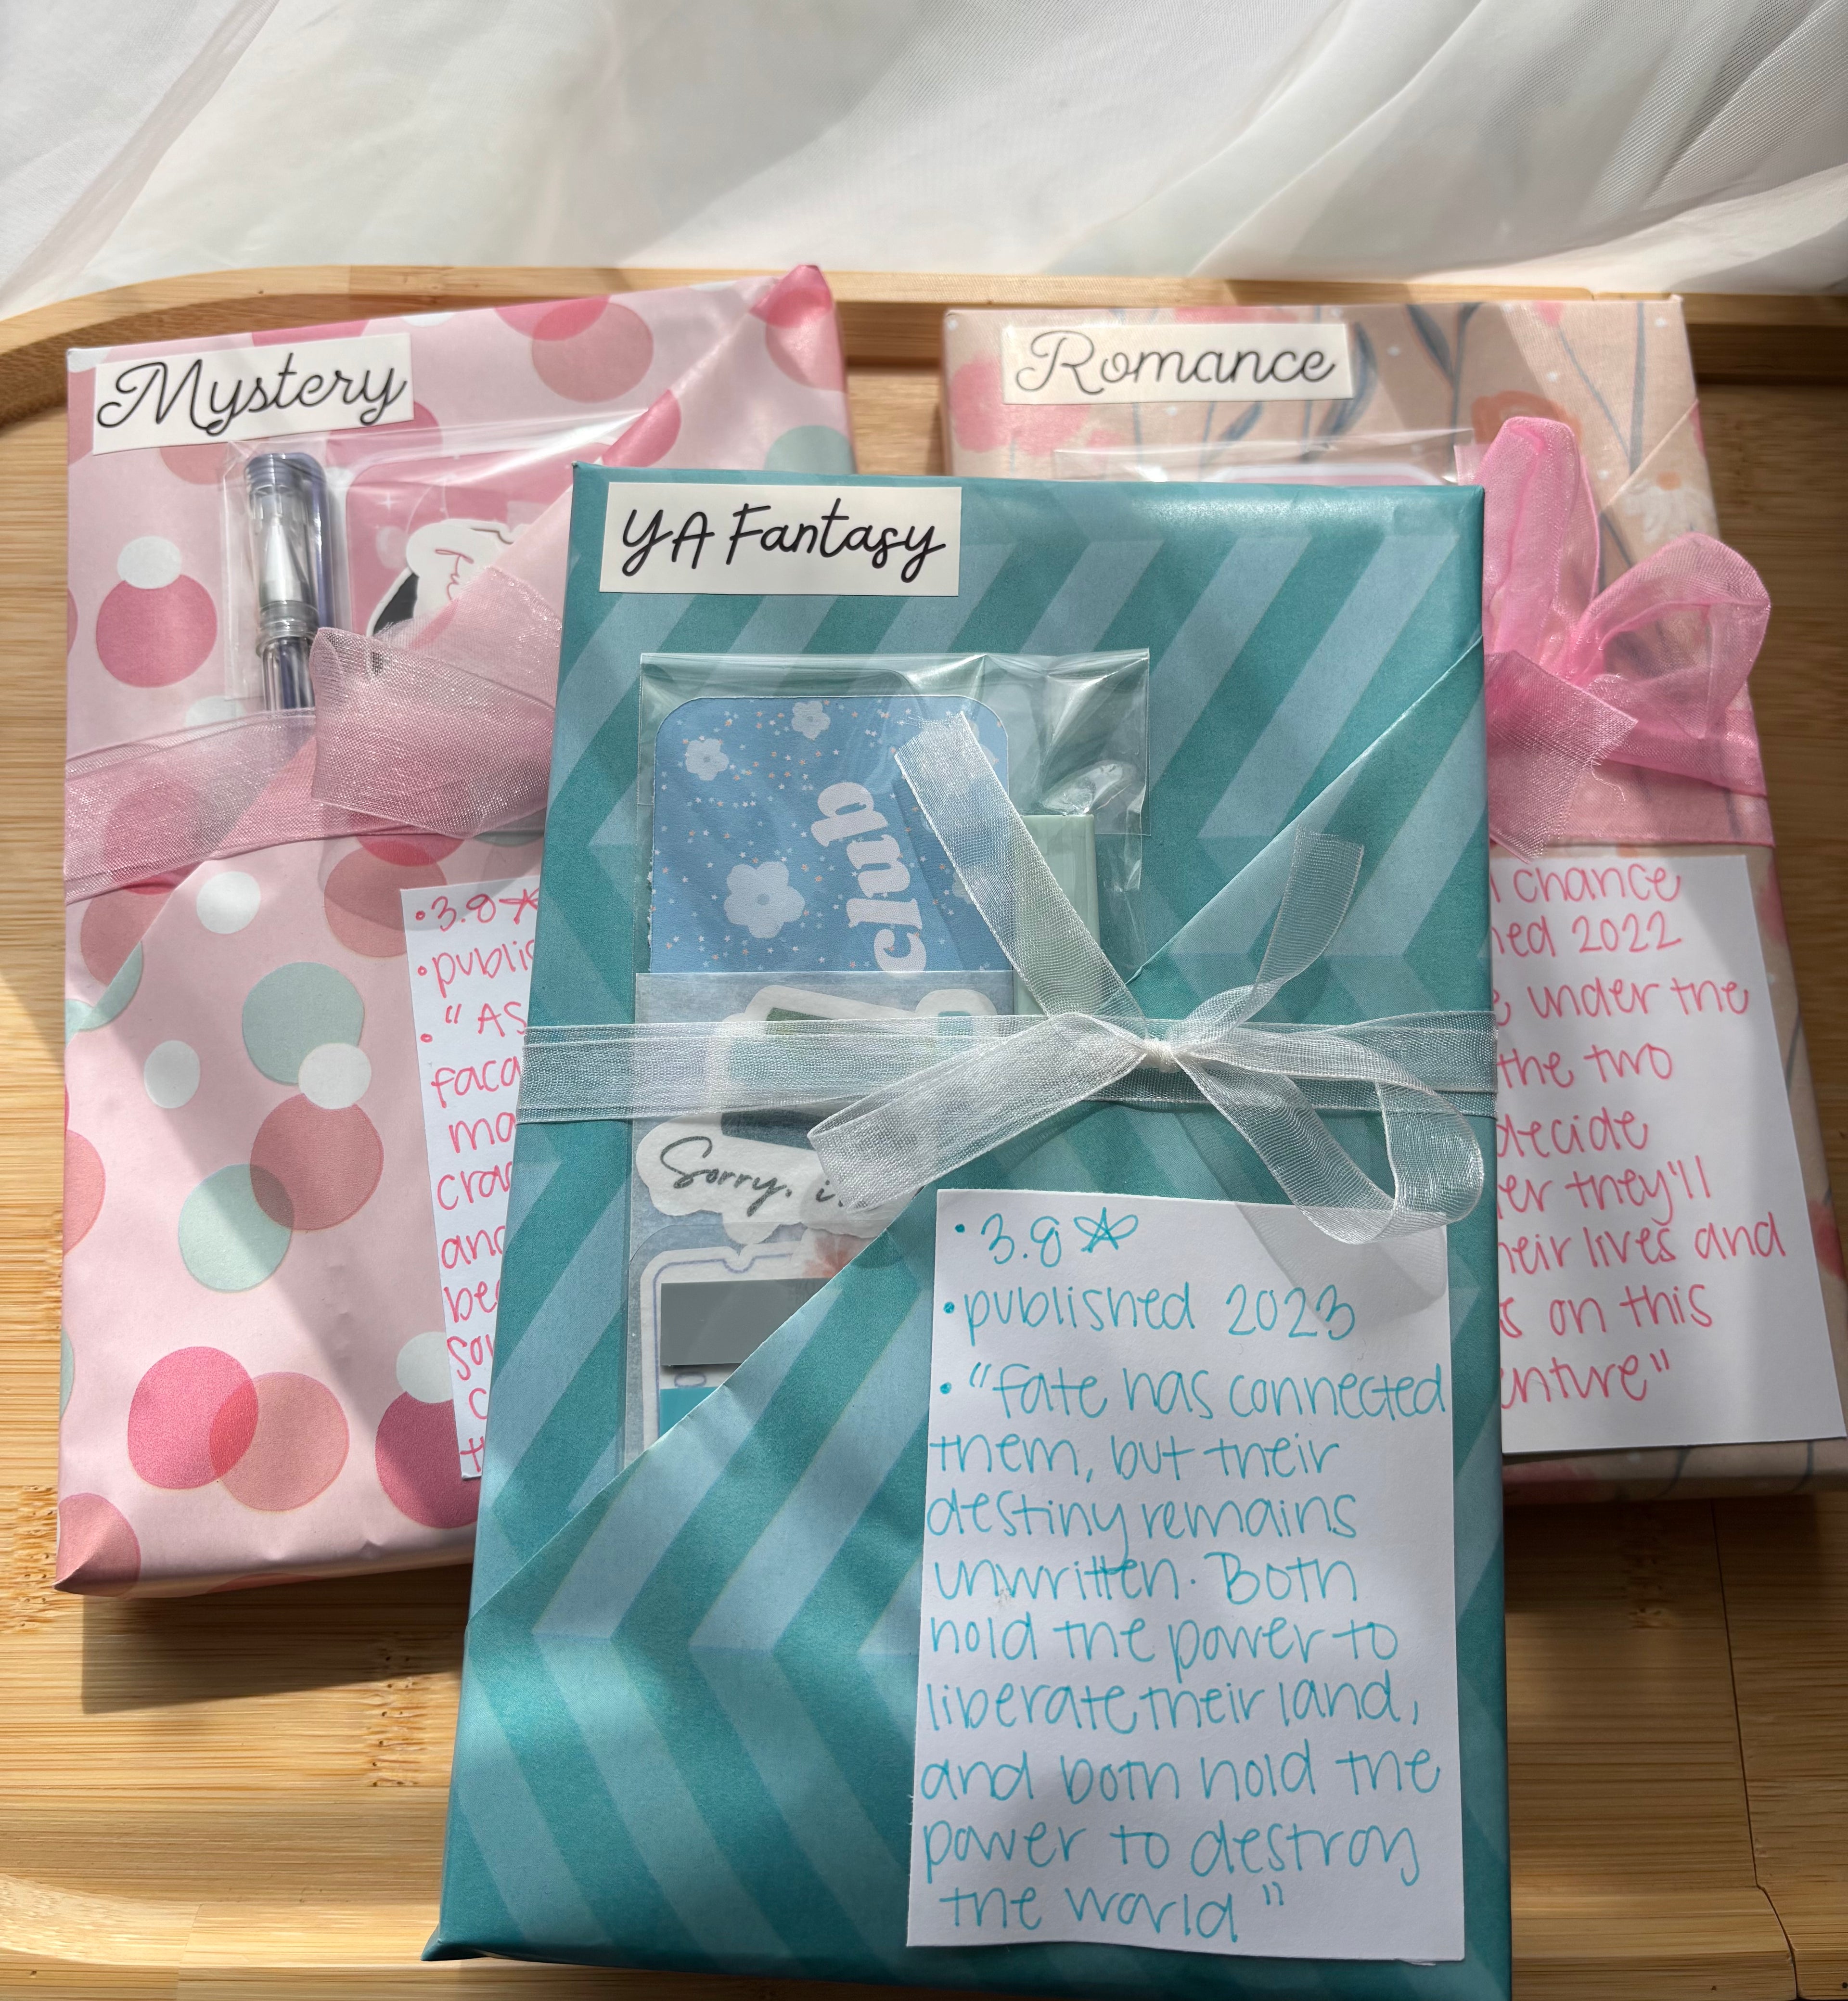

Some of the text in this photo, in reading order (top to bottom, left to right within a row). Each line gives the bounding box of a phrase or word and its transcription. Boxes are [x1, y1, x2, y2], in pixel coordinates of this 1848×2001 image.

[96, 350, 408, 437] Mystery
[1014, 329, 1337, 397] Romance
[621, 497, 948, 584] YA Fantasy
[810, 781, 928, 974] club
[1513, 863, 1681, 903] chance
[1571, 911, 1682, 953] 2022
[1527, 977, 1660, 1019] under
[1670, 977, 1749, 1016] the
[1497, 1043, 1673, 1089] the two
[1565, 1155, 1714, 1228] they'll
[1583, 1221, 1676, 1268] lives
[1694, 1212, 1786, 1260] and
[963, 1281, 1355, 1347] published 2023
[1549, 1297, 1606, 1336] on
[1620, 1283, 1713, 1329] this
[1122, 1367, 1214, 1421] has
[1229, 1363, 1446, 1422] connected
[928, 1433, 1340, 1484] them, but their
[926, 1487, 1356, 1566] destiny remains
[933, 1551, 1358, 1606] unwritten. Both
[929, 1611, 1399, 1683] hold the power to
[925, 1669, 1419, 1735] liberate their land,
[919, 1739, 1441, 1806] and both hold the
[922, 1820, 1420, 1889] power to destroy
[938, 1887, 1041, 1931] the
